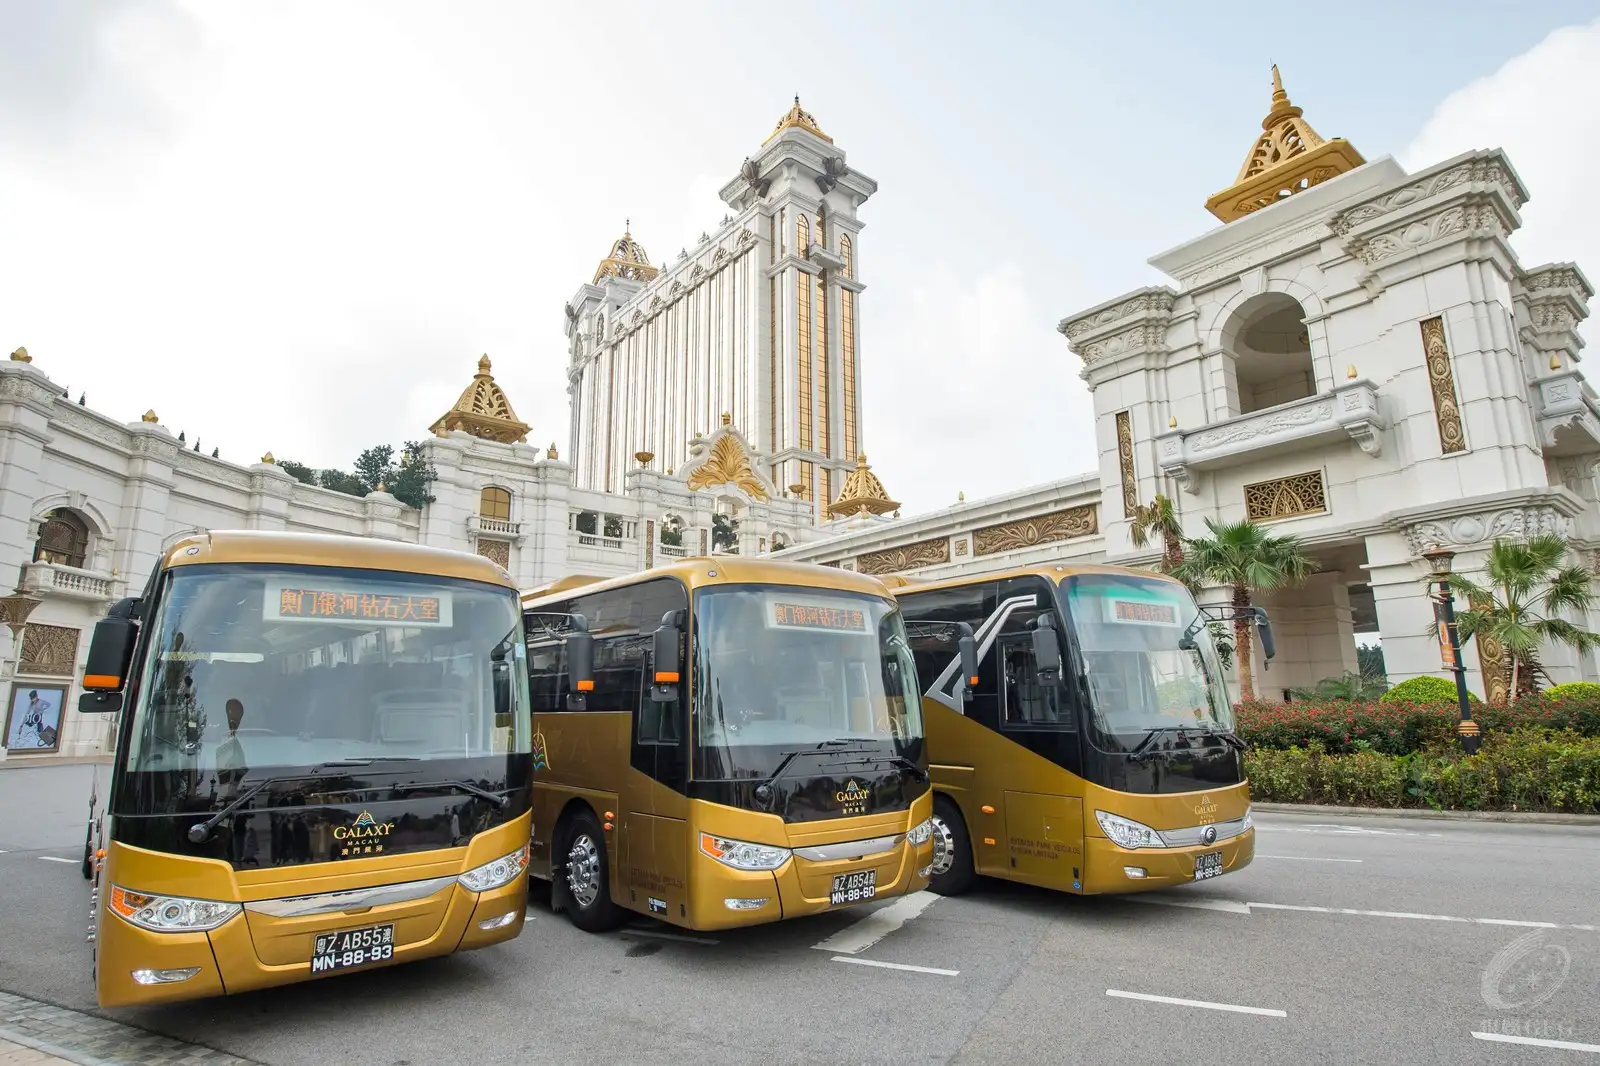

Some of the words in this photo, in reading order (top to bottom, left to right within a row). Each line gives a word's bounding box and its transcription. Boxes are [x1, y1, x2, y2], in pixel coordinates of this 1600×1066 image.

[836, 790, 868, 803] GALAXY
[333, 823, 392, 840] GALAXY
[347, 838, 380, 846] MACAU
[832, 886, 875, 905] MN-88-60
[312, 944, 393, 972] MN-88-93
